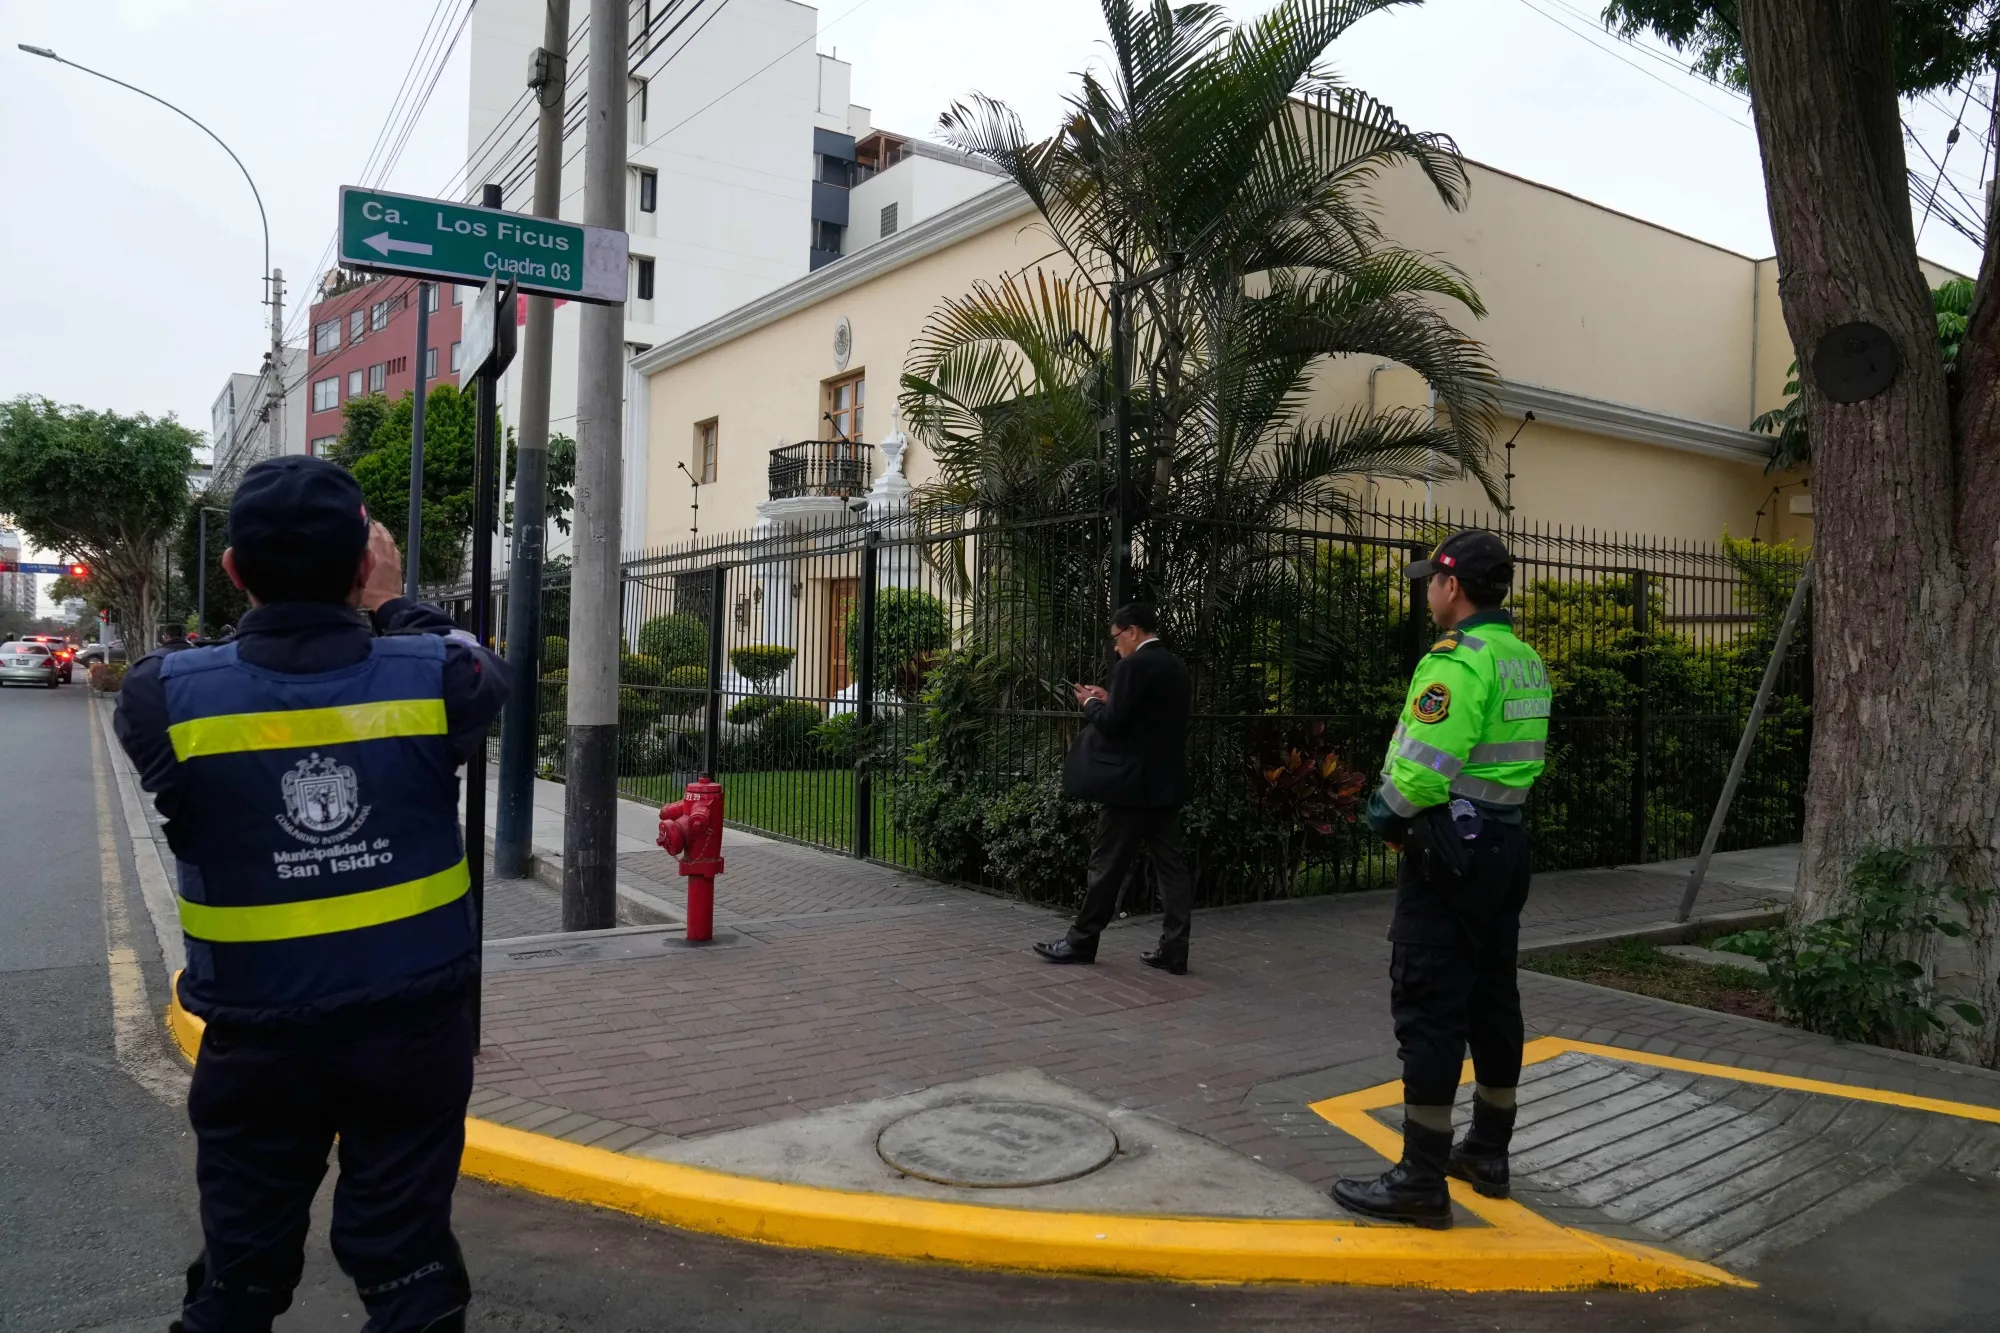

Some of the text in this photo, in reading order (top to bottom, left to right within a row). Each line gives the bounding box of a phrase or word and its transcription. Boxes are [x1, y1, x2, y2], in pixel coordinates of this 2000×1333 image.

[362, 201, 571, 251] Ca. Los Ficus
[483, 251, 571, 282] Cuadra 03
[275, 813, 321, 845] COMUNIDAD
[273, 837, 390, 863] Municipalidad de
[276, 852, 393, 879] San Isidro
